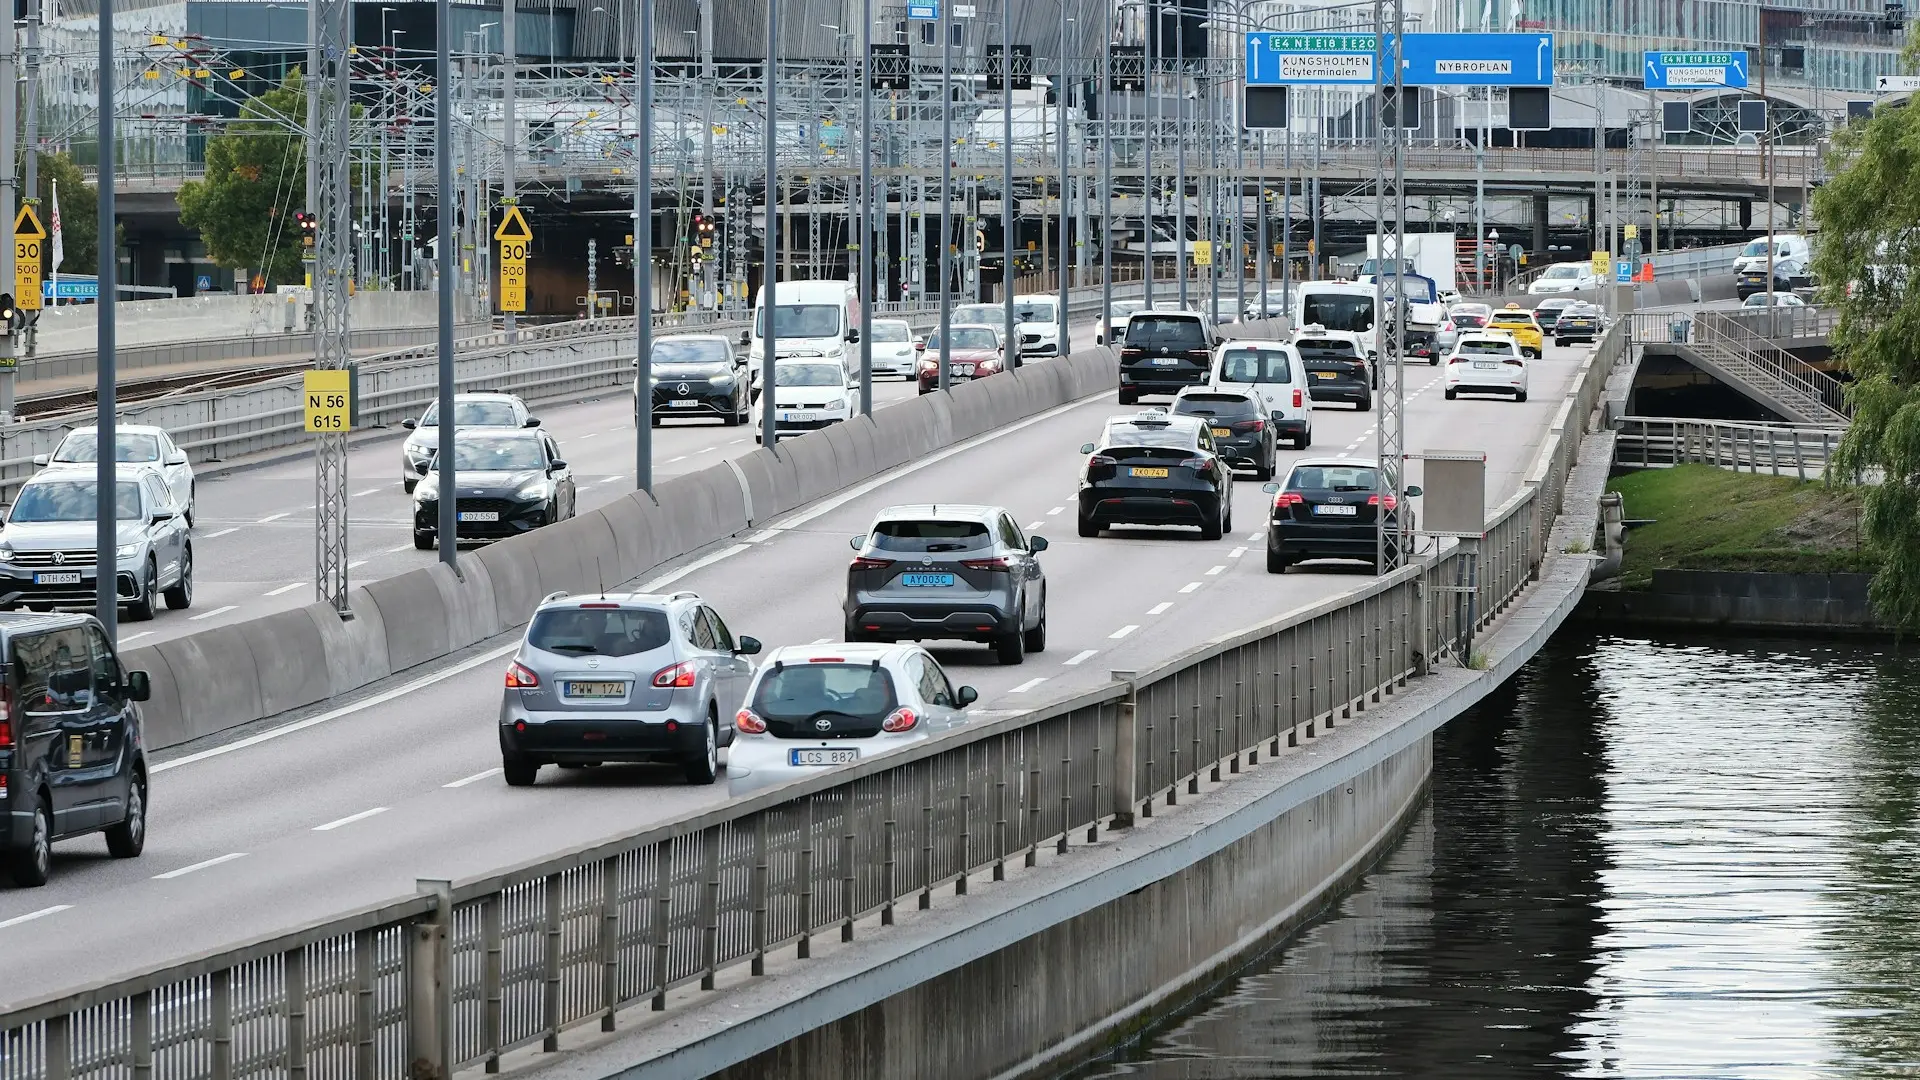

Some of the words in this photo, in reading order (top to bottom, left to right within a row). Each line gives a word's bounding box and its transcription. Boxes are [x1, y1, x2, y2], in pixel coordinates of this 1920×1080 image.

[1274, 39, 1290, 48] E4
[1294, 39, 1303, 48] N
[1316, 39, 1336, 48] E18
[1351, 39, 1375, 48] E20
[1282, 57, 1369, 66] KUNGSHOLMEN
[1663, 55, 1674, 63] E4
[1439, 62, 1508, 71] NYBROPLAN
[1282, 67, 1357, 77] Cityterminalen
[1668, 68, 1723, 76] KUNGSHOLMEN
[1668, 76, 1716, 84] Citytermen
[17, 243, 39, 259] 30
[503, 244, 525, 260] 30
[17, 265, 39, 274] 500
[502, 266, 524, 276] 500
[23, 276, 32, 284] m
[0, 358, 15, 366] -19
[310, 395, 320, 408] N
[326, 395, 345, 408] 56
[313, 415, 341, 428] 615
[1134, 468, 1149, 476] ZKO
[1151, 469, 1165, 477] 747
[1339, 506, 1354, 514] 511
[464, 512, 478, 521] SDZ
[480, 512, 496, 520] 55G
[41, 574, 58, 583] DTH
[59, 573, 77, 583] 65M
[909, 575, 947, 584] AY003C
[571, 683, 592, 695] PWW
[602, 683, 622, 694] 174
[800, 752, 822, 763] LCS
[831, 752, 854, 763] 882
